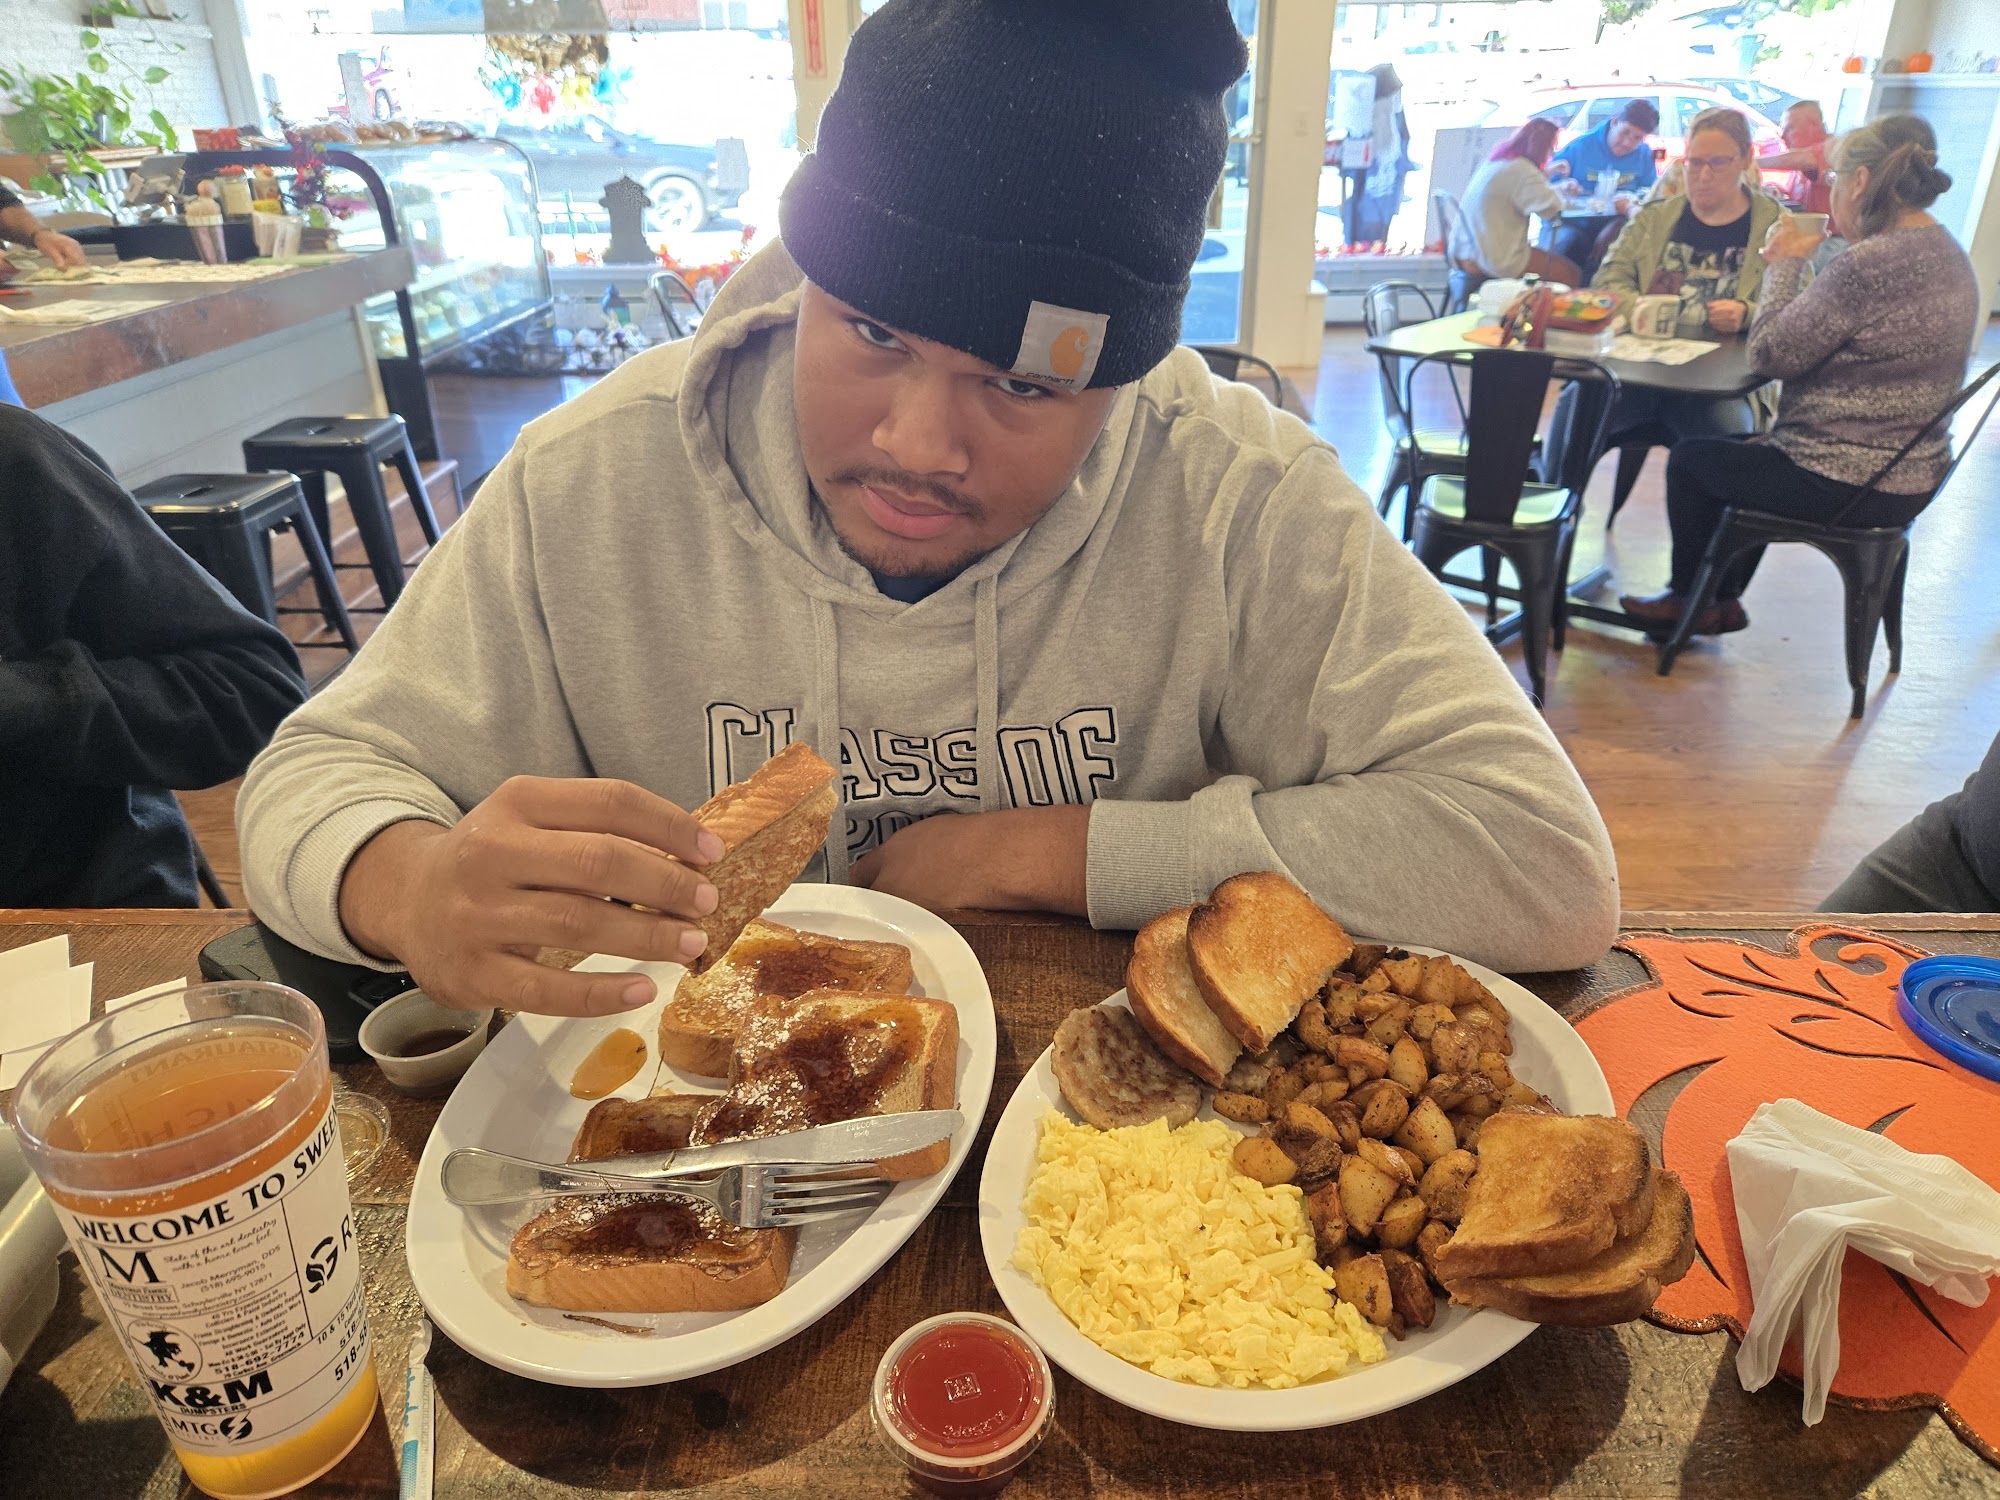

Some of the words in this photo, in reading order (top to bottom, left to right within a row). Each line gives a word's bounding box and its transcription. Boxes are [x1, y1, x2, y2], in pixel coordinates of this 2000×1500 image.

[994, 705, 1118, 810] OF
[71, 1200, 235, 1245] WELCOME
[241, 1173, 286, 1212] TO
[236, 1218, 277, 1240] dentistry
[97, 1247, 167, 1284] M
[181, 1277, 208, 1289] Jacob
[262, 1246, 281, 1259] DDS
[200, 1281, 223, 1292] (518)
[317, 1332, 329, 1345] 10
[150, 1370, 273, 1407] K&M
[180, 1403, 247, 1415] DUMPSTERS
[172, 1418, 218, 1435] MTG
